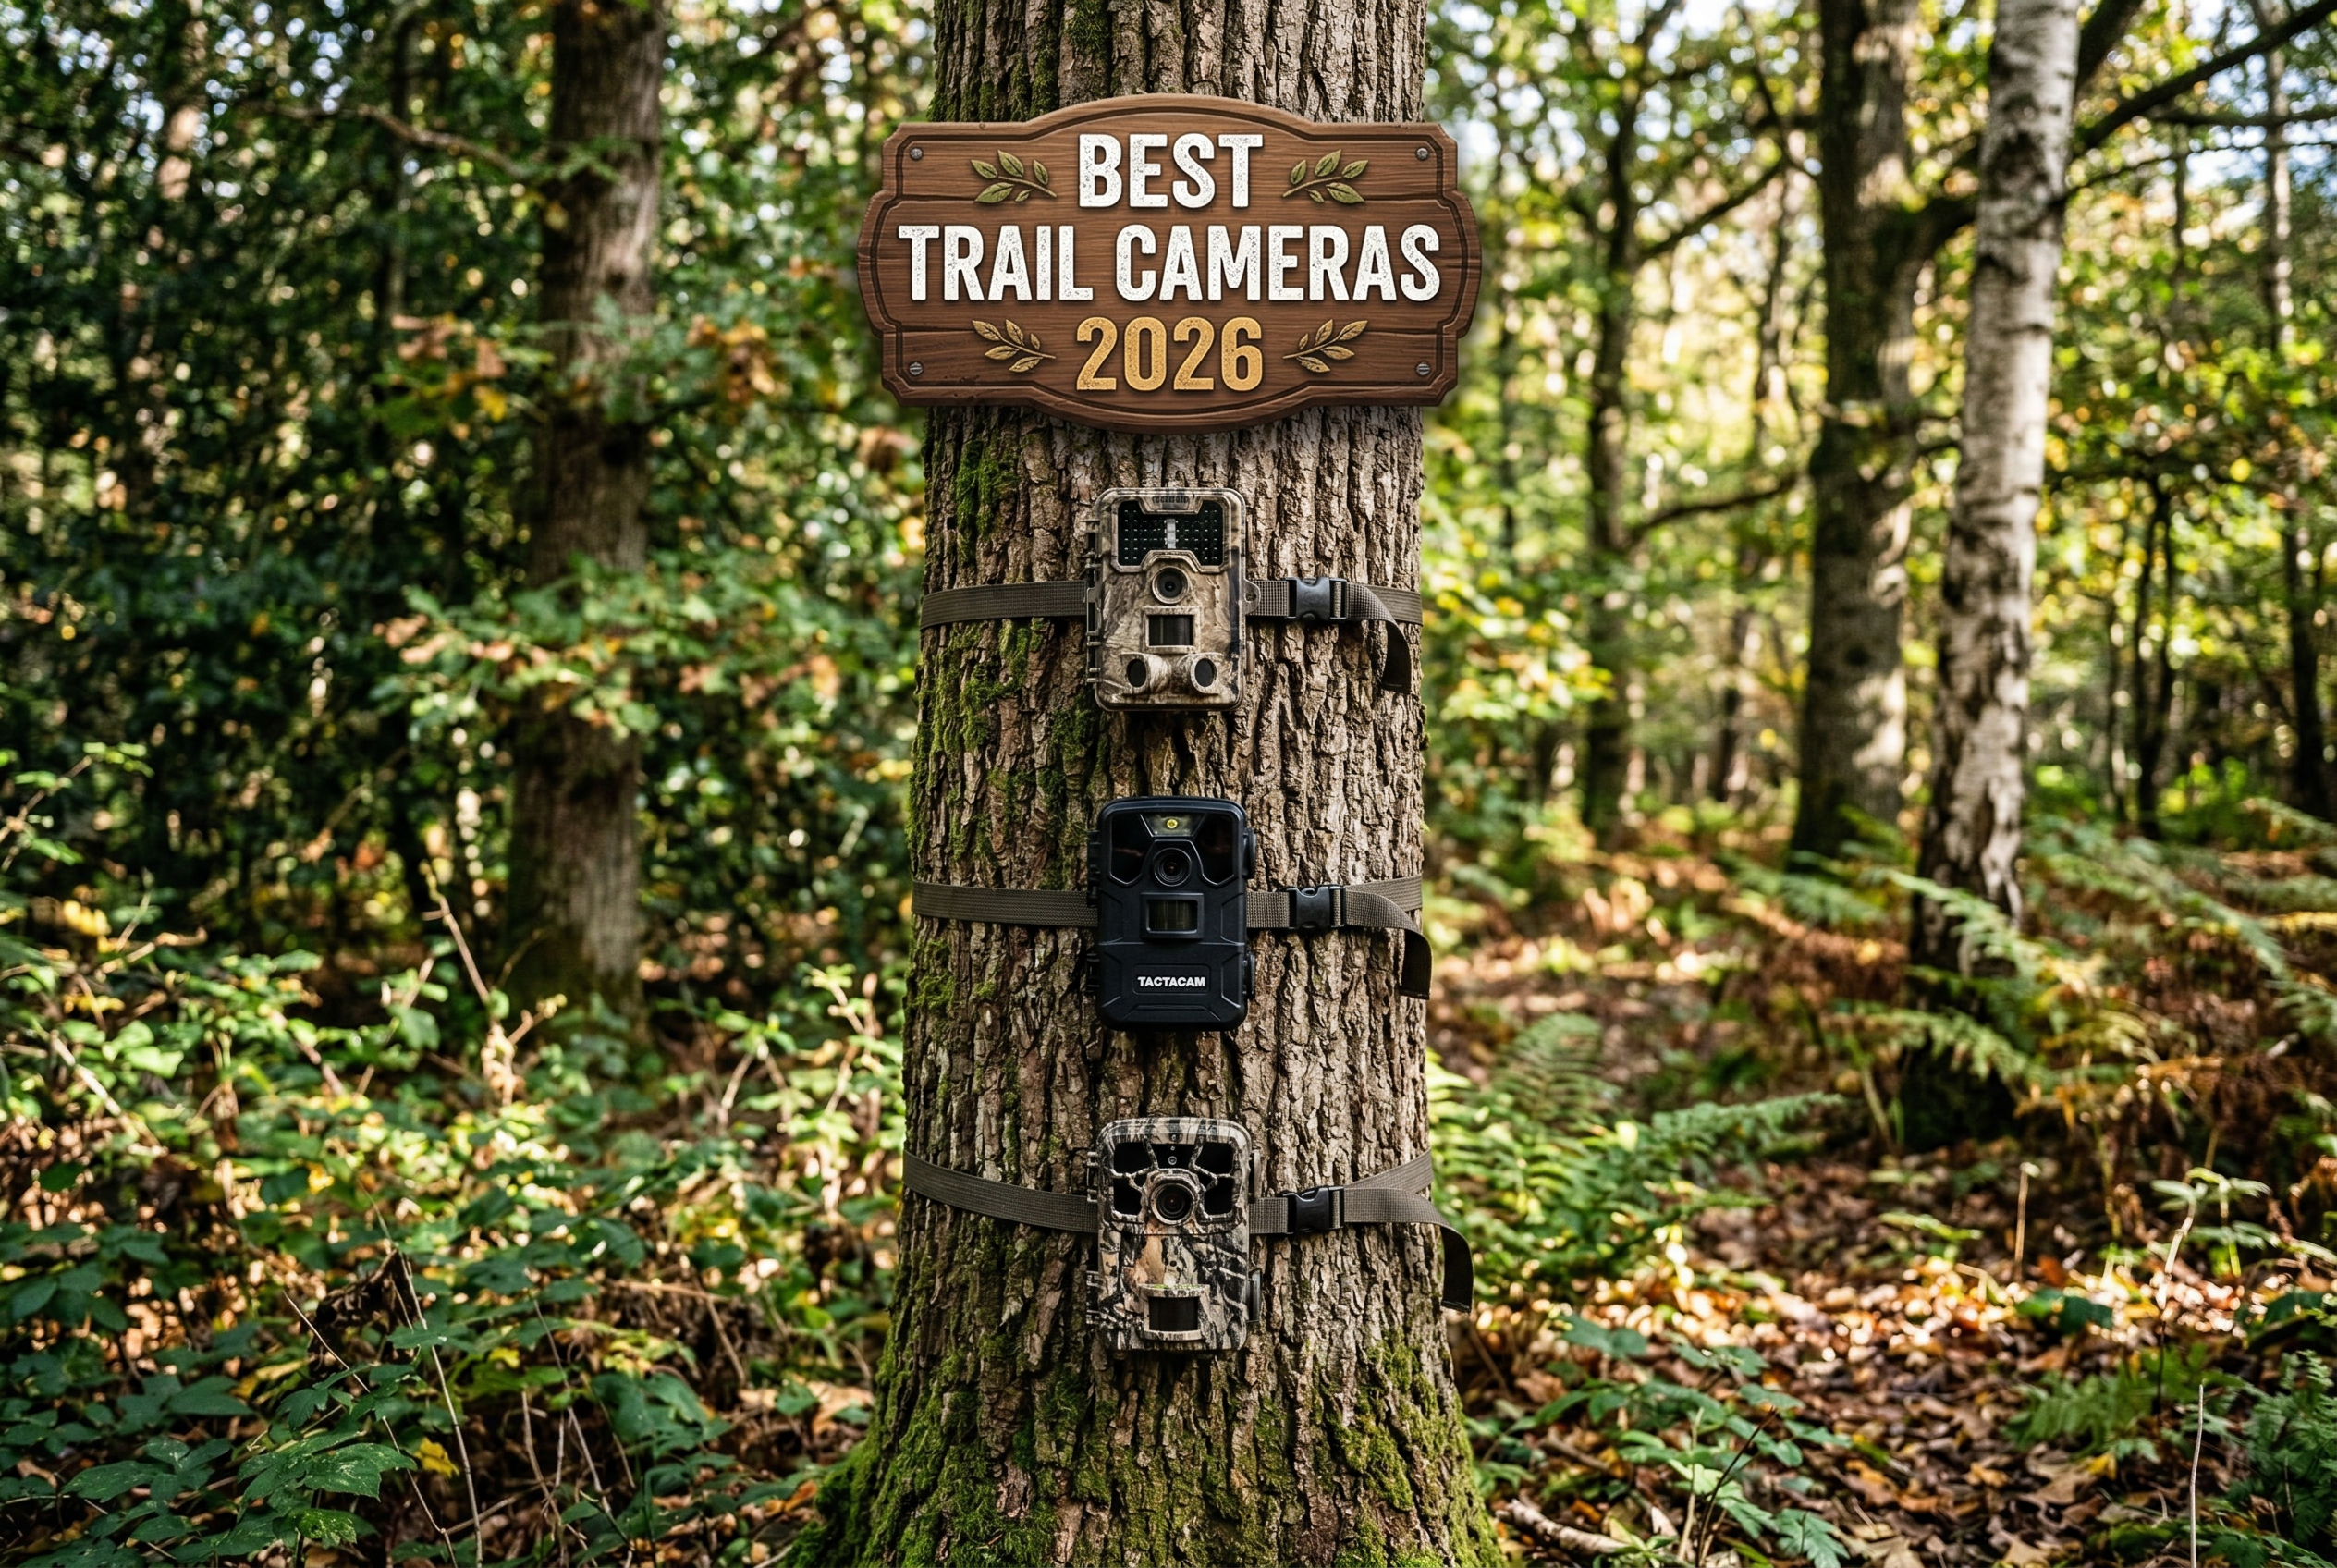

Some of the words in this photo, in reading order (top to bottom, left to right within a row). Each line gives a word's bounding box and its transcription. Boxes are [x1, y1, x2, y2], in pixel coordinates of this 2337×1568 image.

[1078, 133, 1264, 208] BEST
[898, 225, 1094, 301] TRAIL
[1116, 224, 1441, 301] CAMERAS
[1075, 316, 1263, 391] 2026
[1137, 976, 1206, 987] TACTACAM
